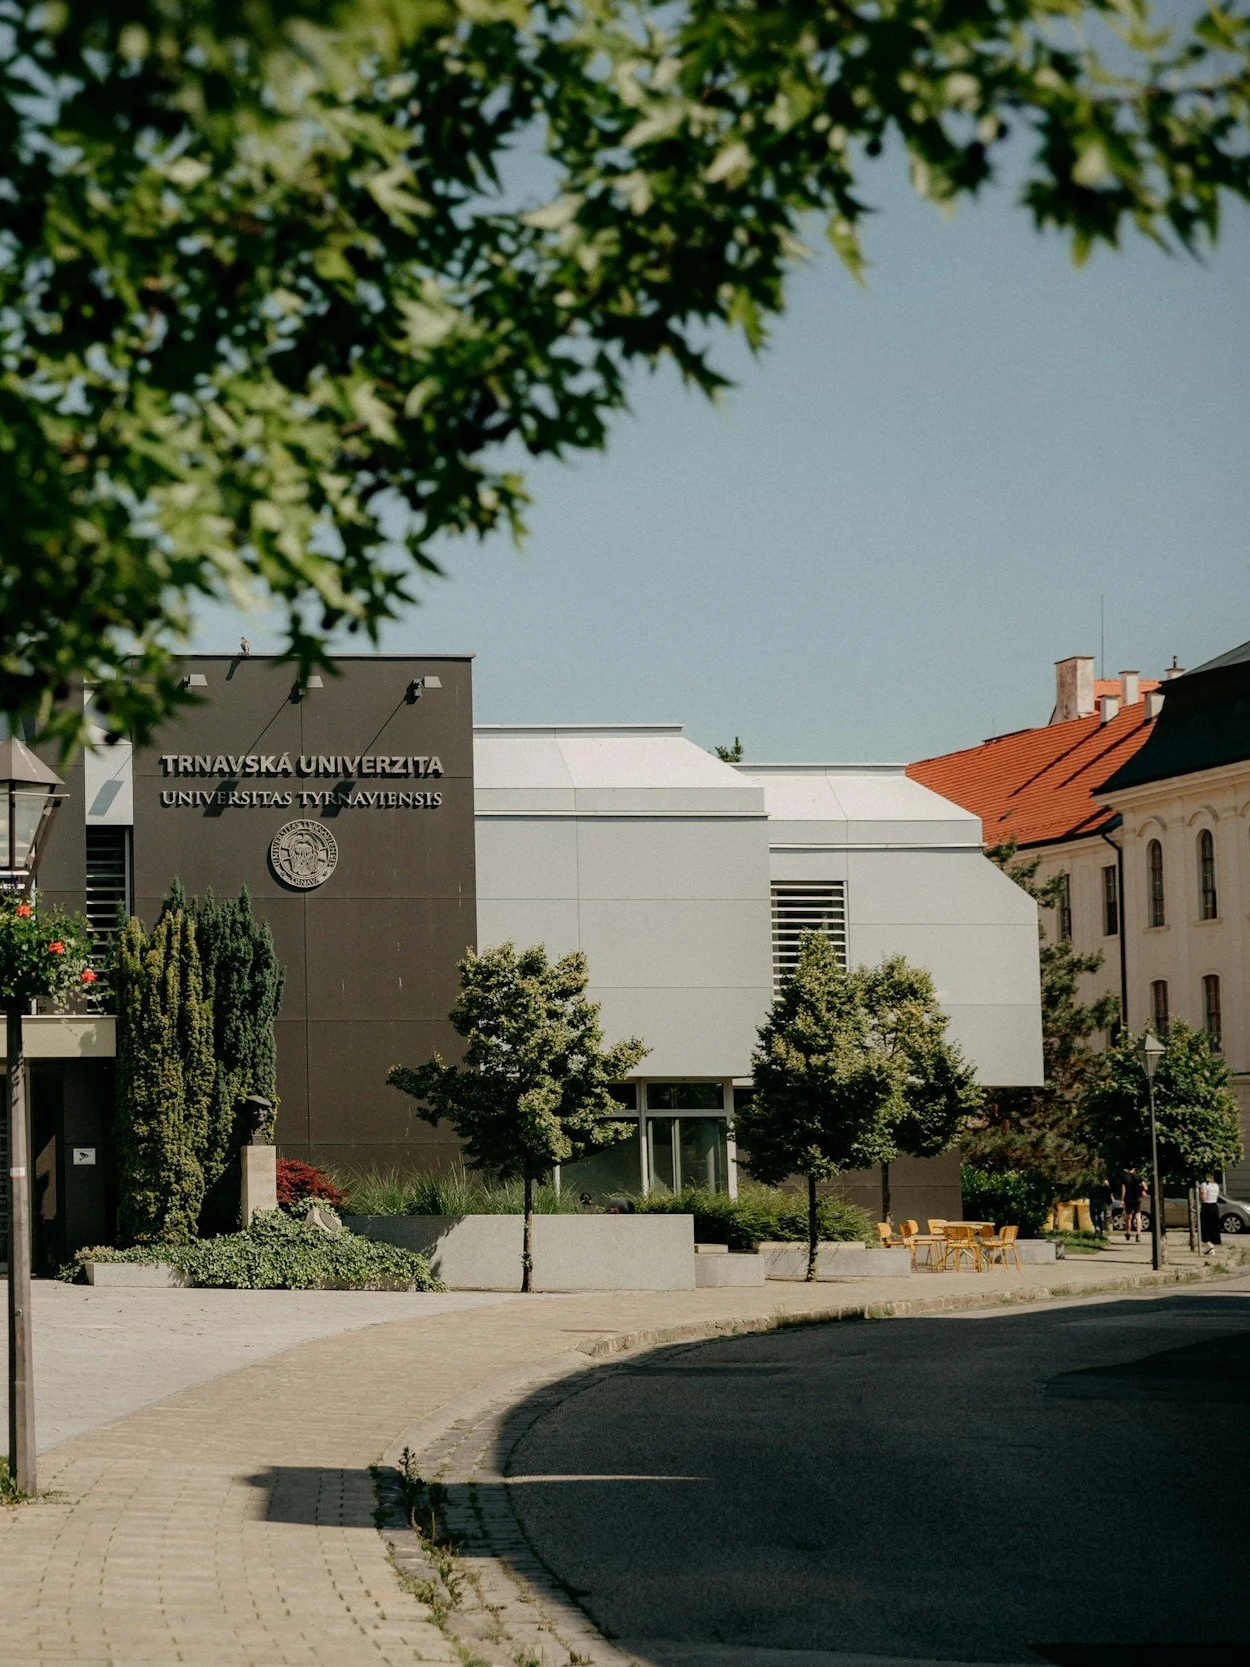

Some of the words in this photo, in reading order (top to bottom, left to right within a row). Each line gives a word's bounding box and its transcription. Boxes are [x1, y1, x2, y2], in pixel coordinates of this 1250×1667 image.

[161, 752, 293, 773] TRNAVSKÁ
[299, 755, 445, 774] UNIVERZITA
[161, 790, 293, 805] UNIVERSITAS
[298, 791, 443, 806] TYRNAVIENSIS
